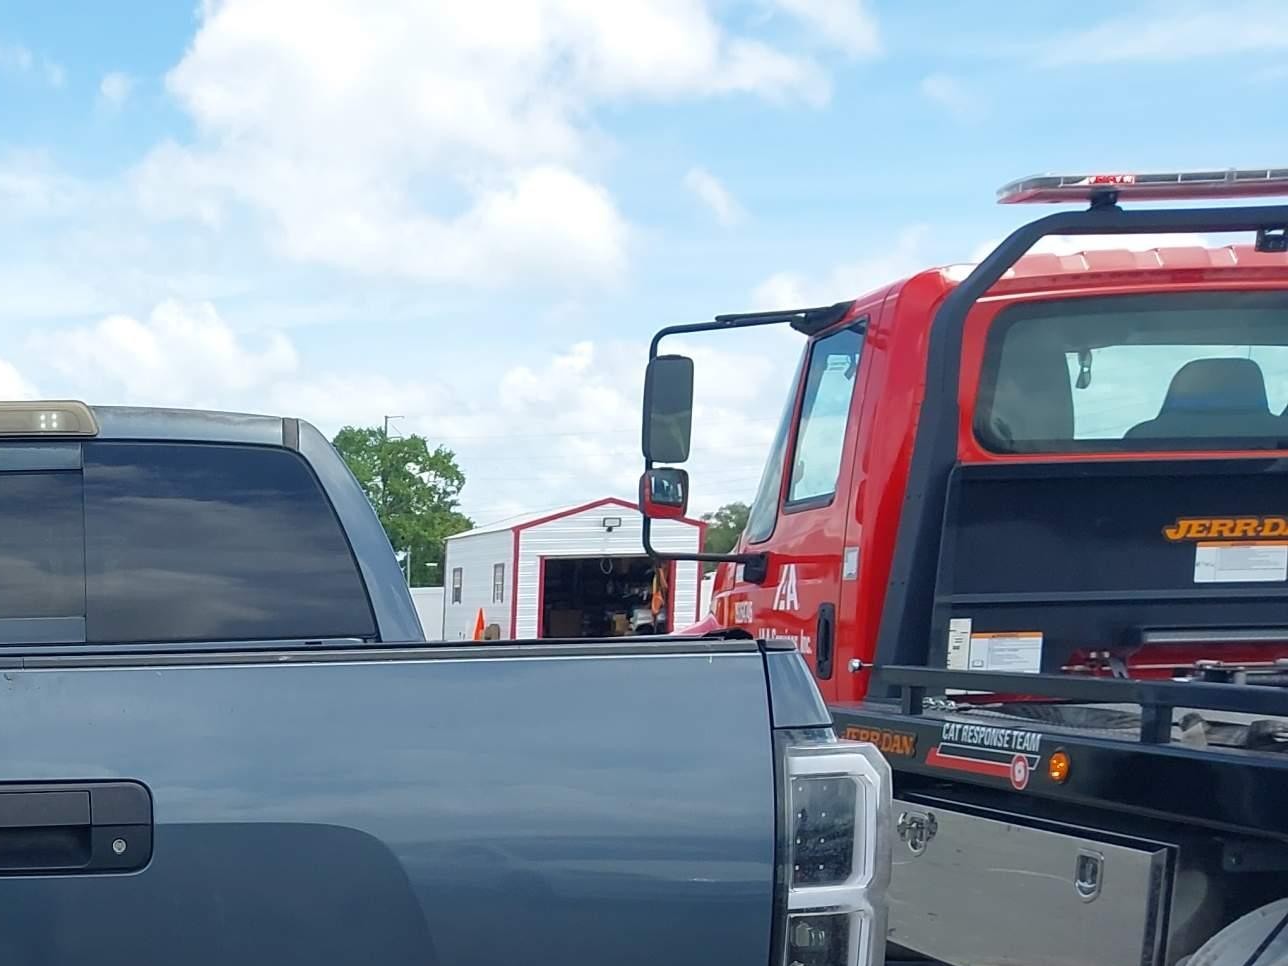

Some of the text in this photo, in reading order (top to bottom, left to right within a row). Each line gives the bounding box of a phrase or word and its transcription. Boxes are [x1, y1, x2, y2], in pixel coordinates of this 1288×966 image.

[941, 723, 1043, 752] CAT RESPONSE TEAM
